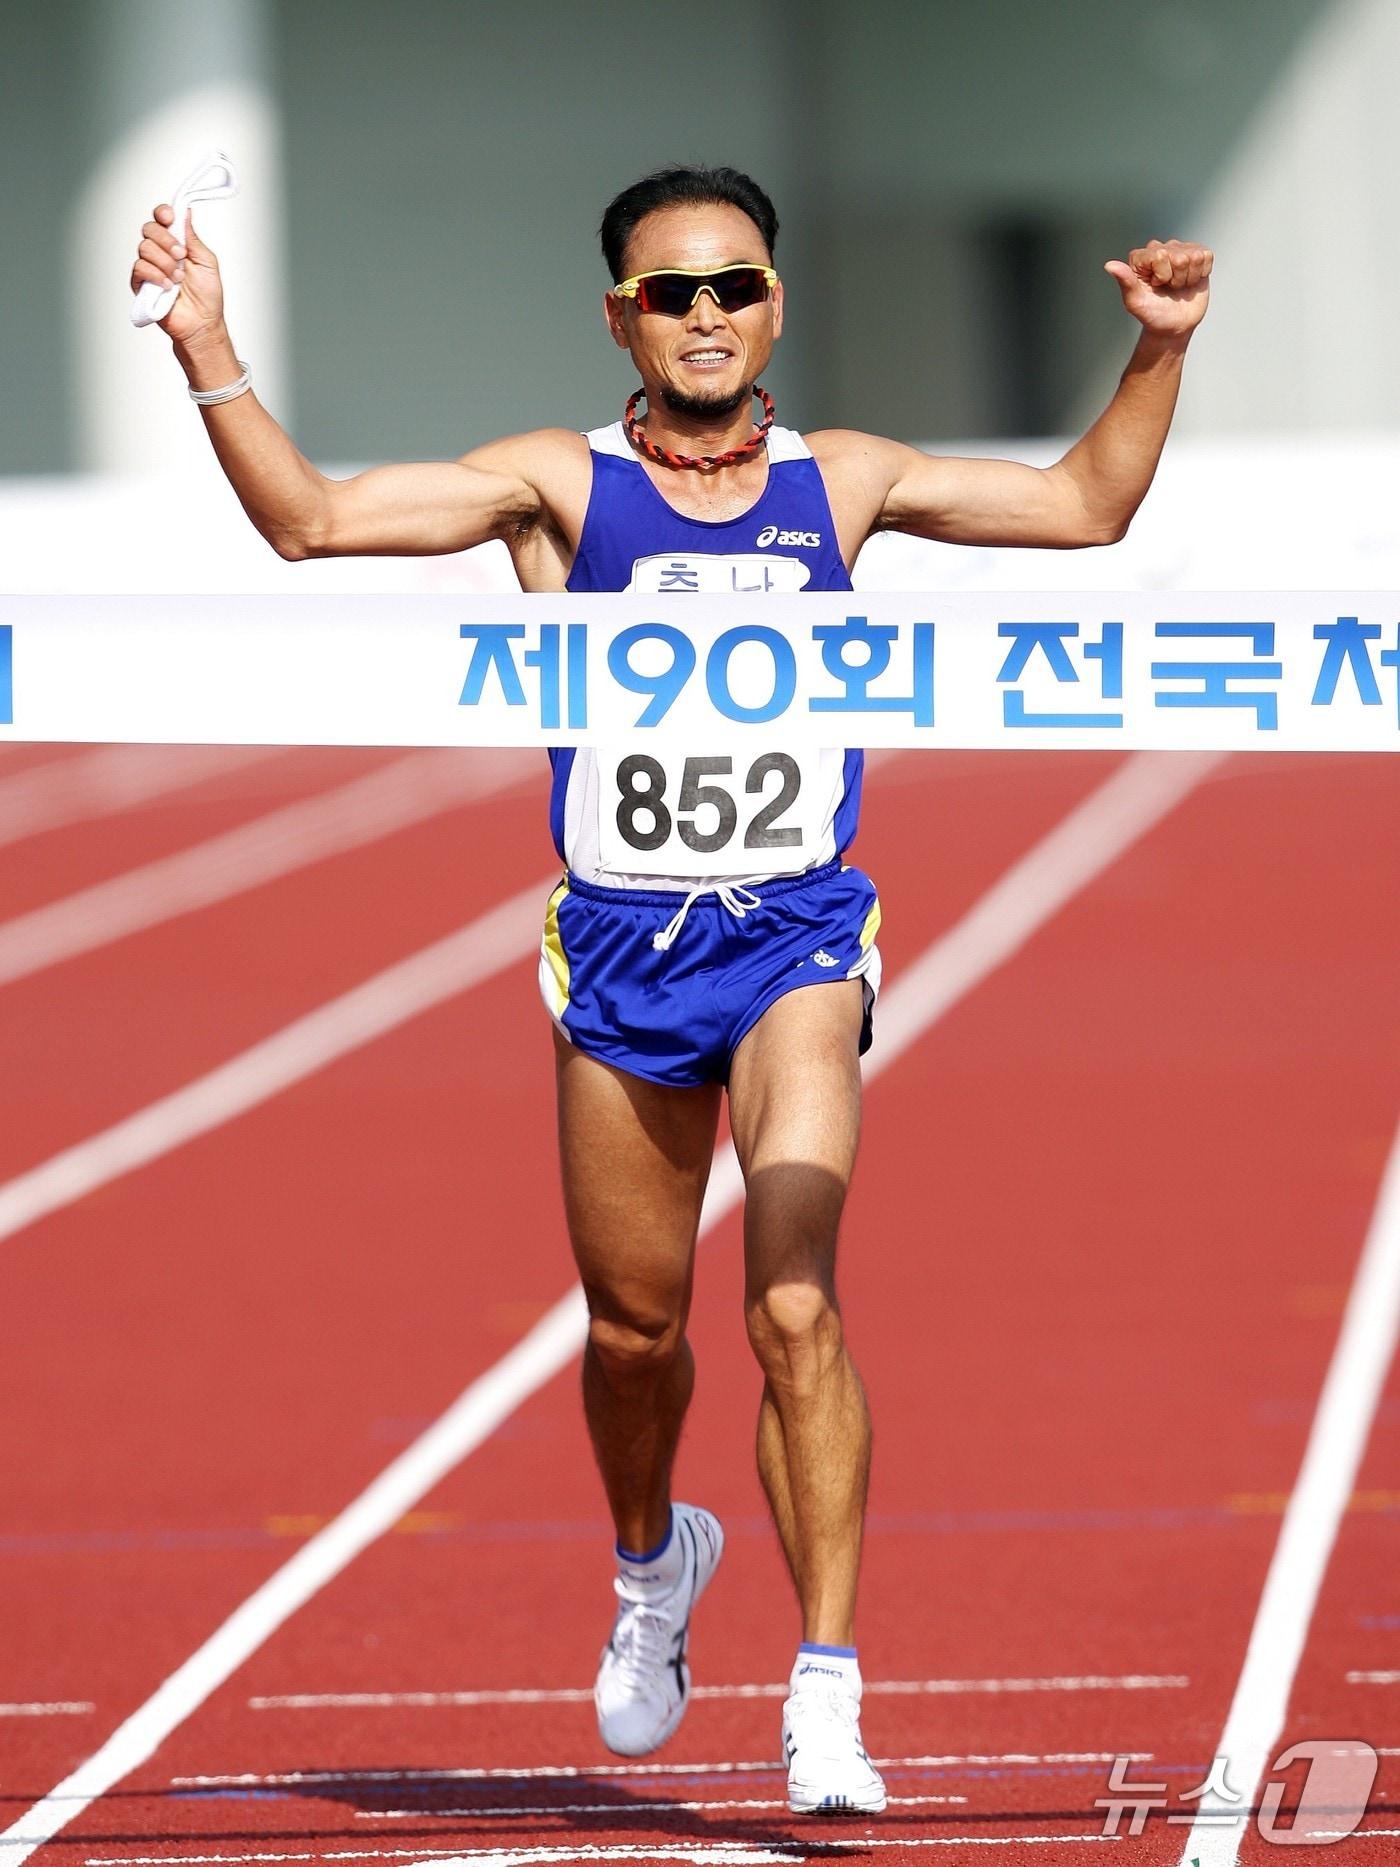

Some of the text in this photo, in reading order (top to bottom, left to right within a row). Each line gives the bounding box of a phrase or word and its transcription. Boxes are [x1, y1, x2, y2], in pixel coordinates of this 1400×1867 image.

[776, 530, 821, 548] asics
[458, 616, 935, 730] 제90회
[616, 752, 803, 853] 852
